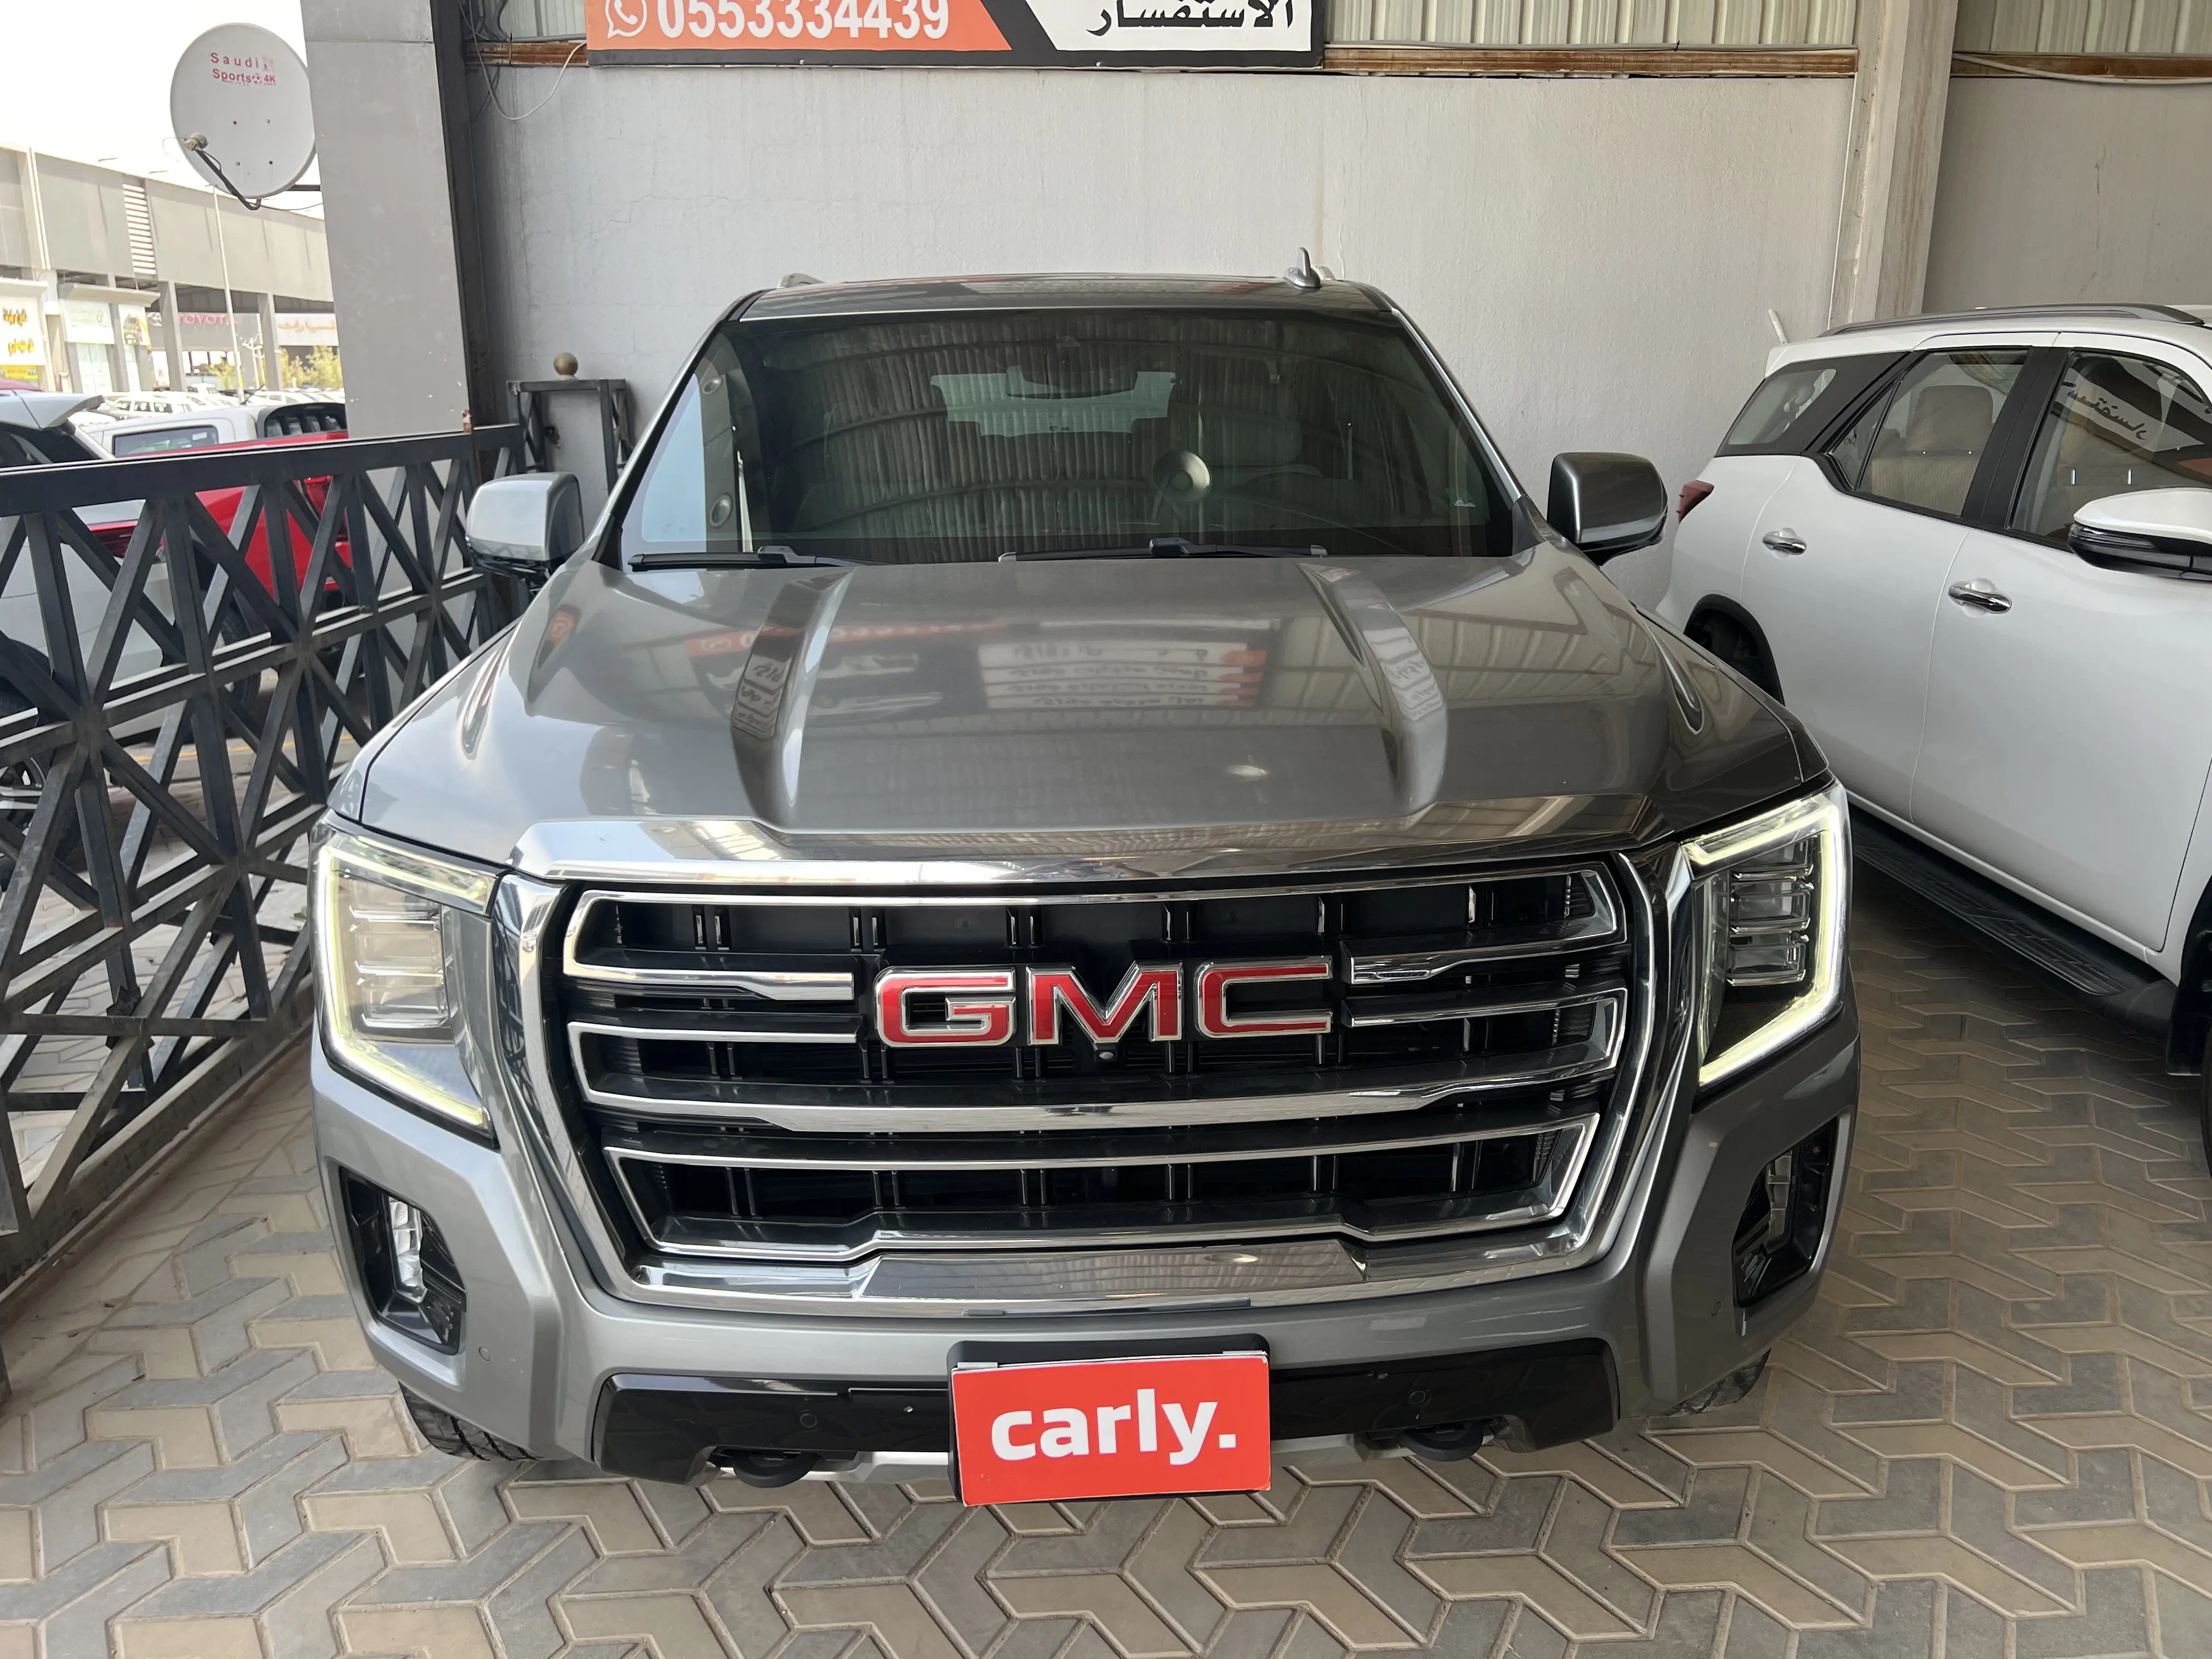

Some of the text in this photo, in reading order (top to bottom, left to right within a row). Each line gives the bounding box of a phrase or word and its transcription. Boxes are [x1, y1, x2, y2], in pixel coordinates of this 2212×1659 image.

[657, 0, 949, 40] 0553334439
[211, 52, 259, 68] Saudi
[212, 68, 251, 83] Sports
[874, 956, 1334, 1048] GMC
[991, 1388, 1237, 1466] carly.
